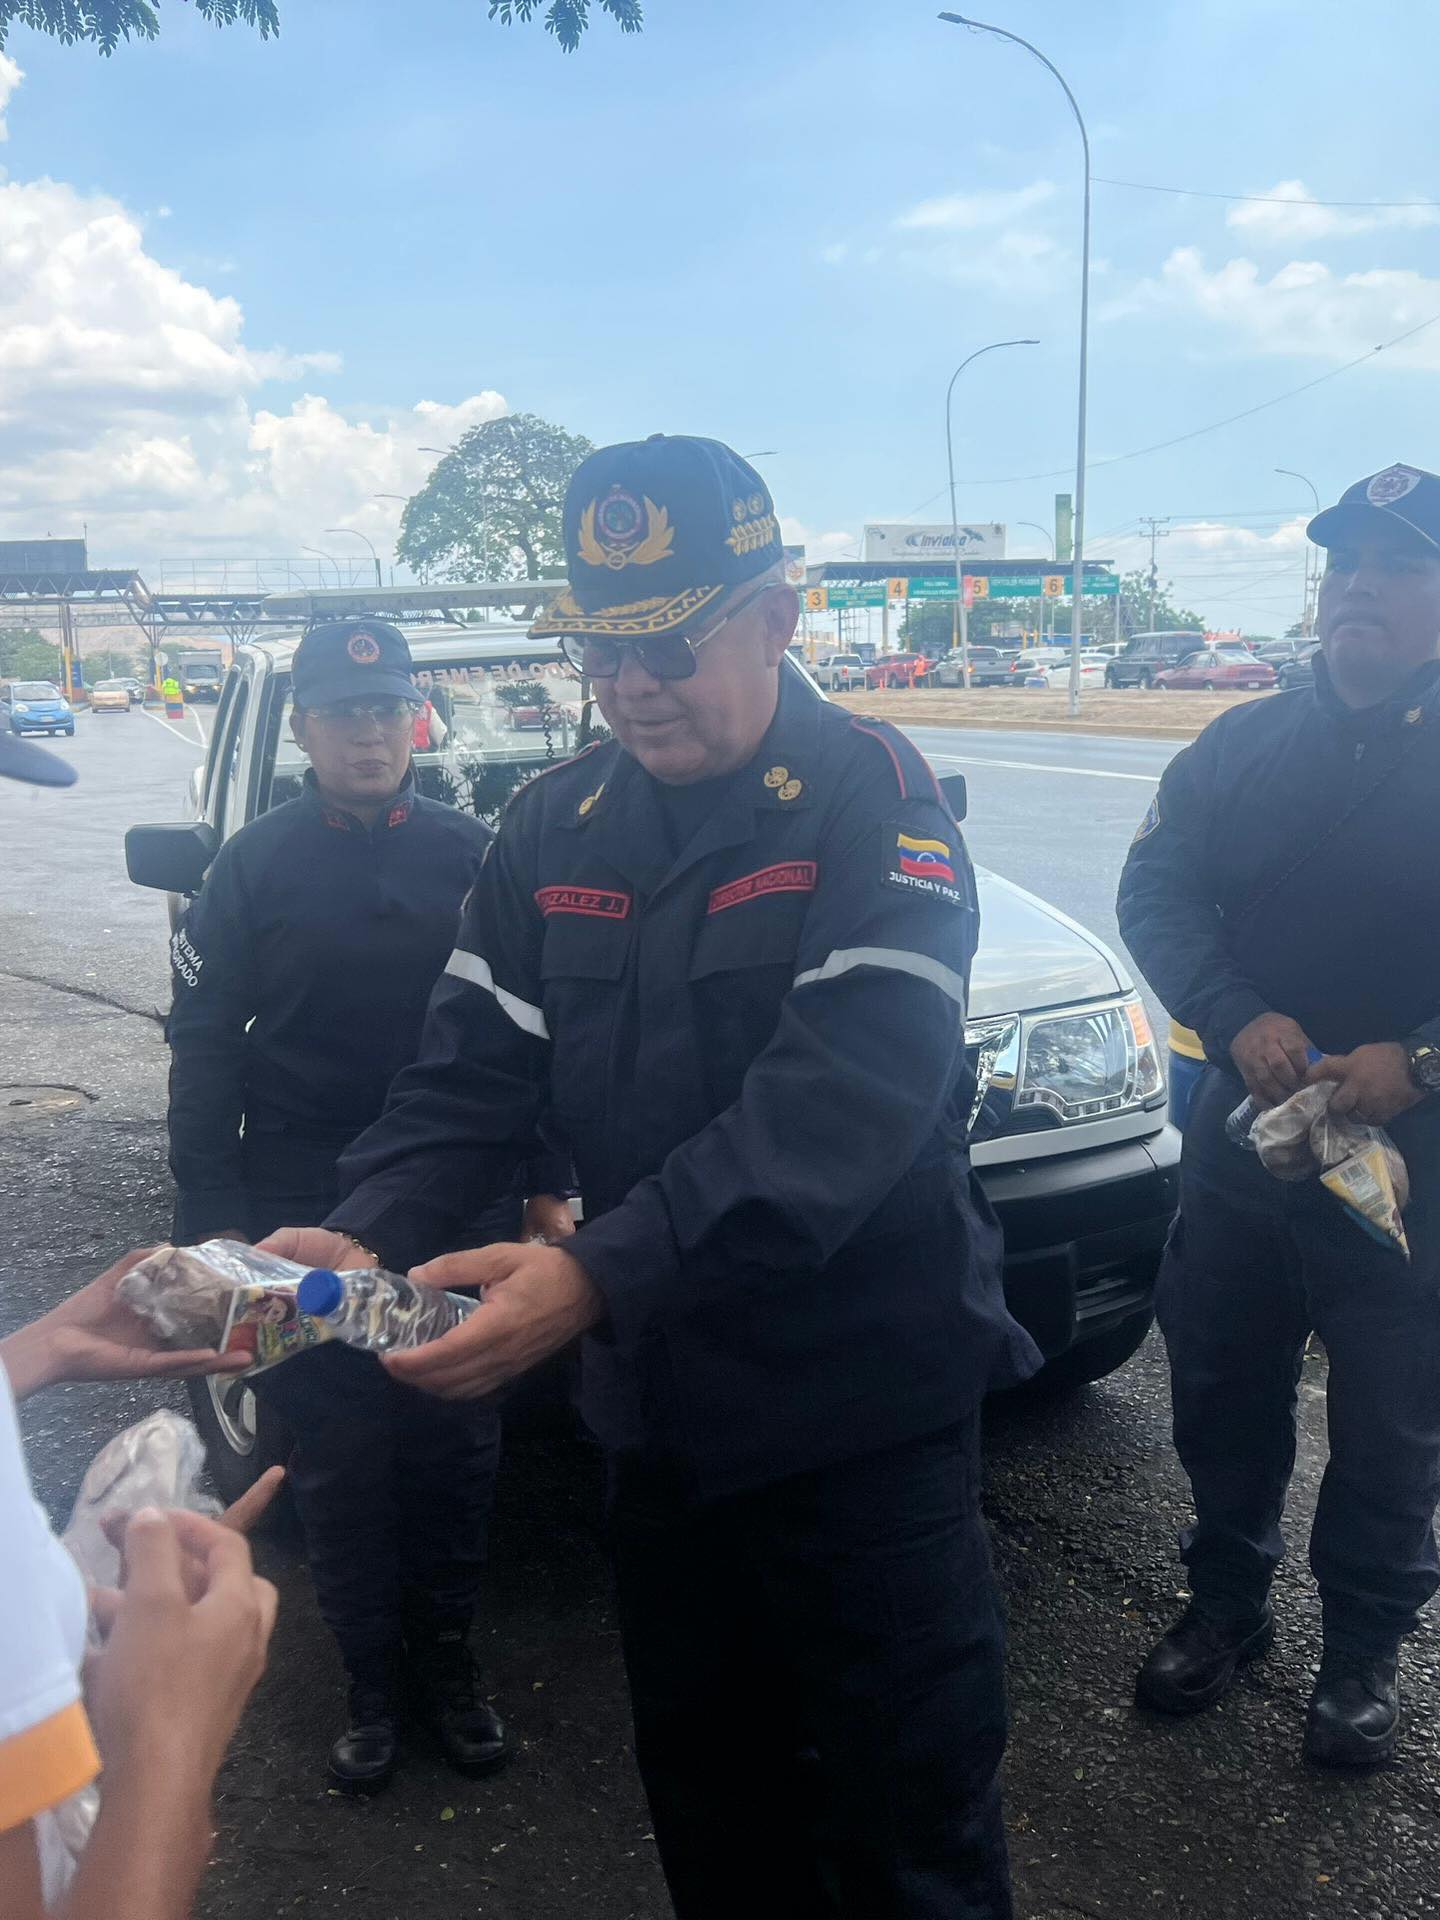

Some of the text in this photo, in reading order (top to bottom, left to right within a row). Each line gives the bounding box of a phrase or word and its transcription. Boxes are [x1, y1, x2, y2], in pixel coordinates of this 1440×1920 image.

[894, 580, 902, 597] 4
[973, 579, 982, 594] 5
[1049, 579, 1058, 593] 6
[812, 591, 822, 607] 3
[889, 871, 961, 901] JUSTICIA Y PAZ
